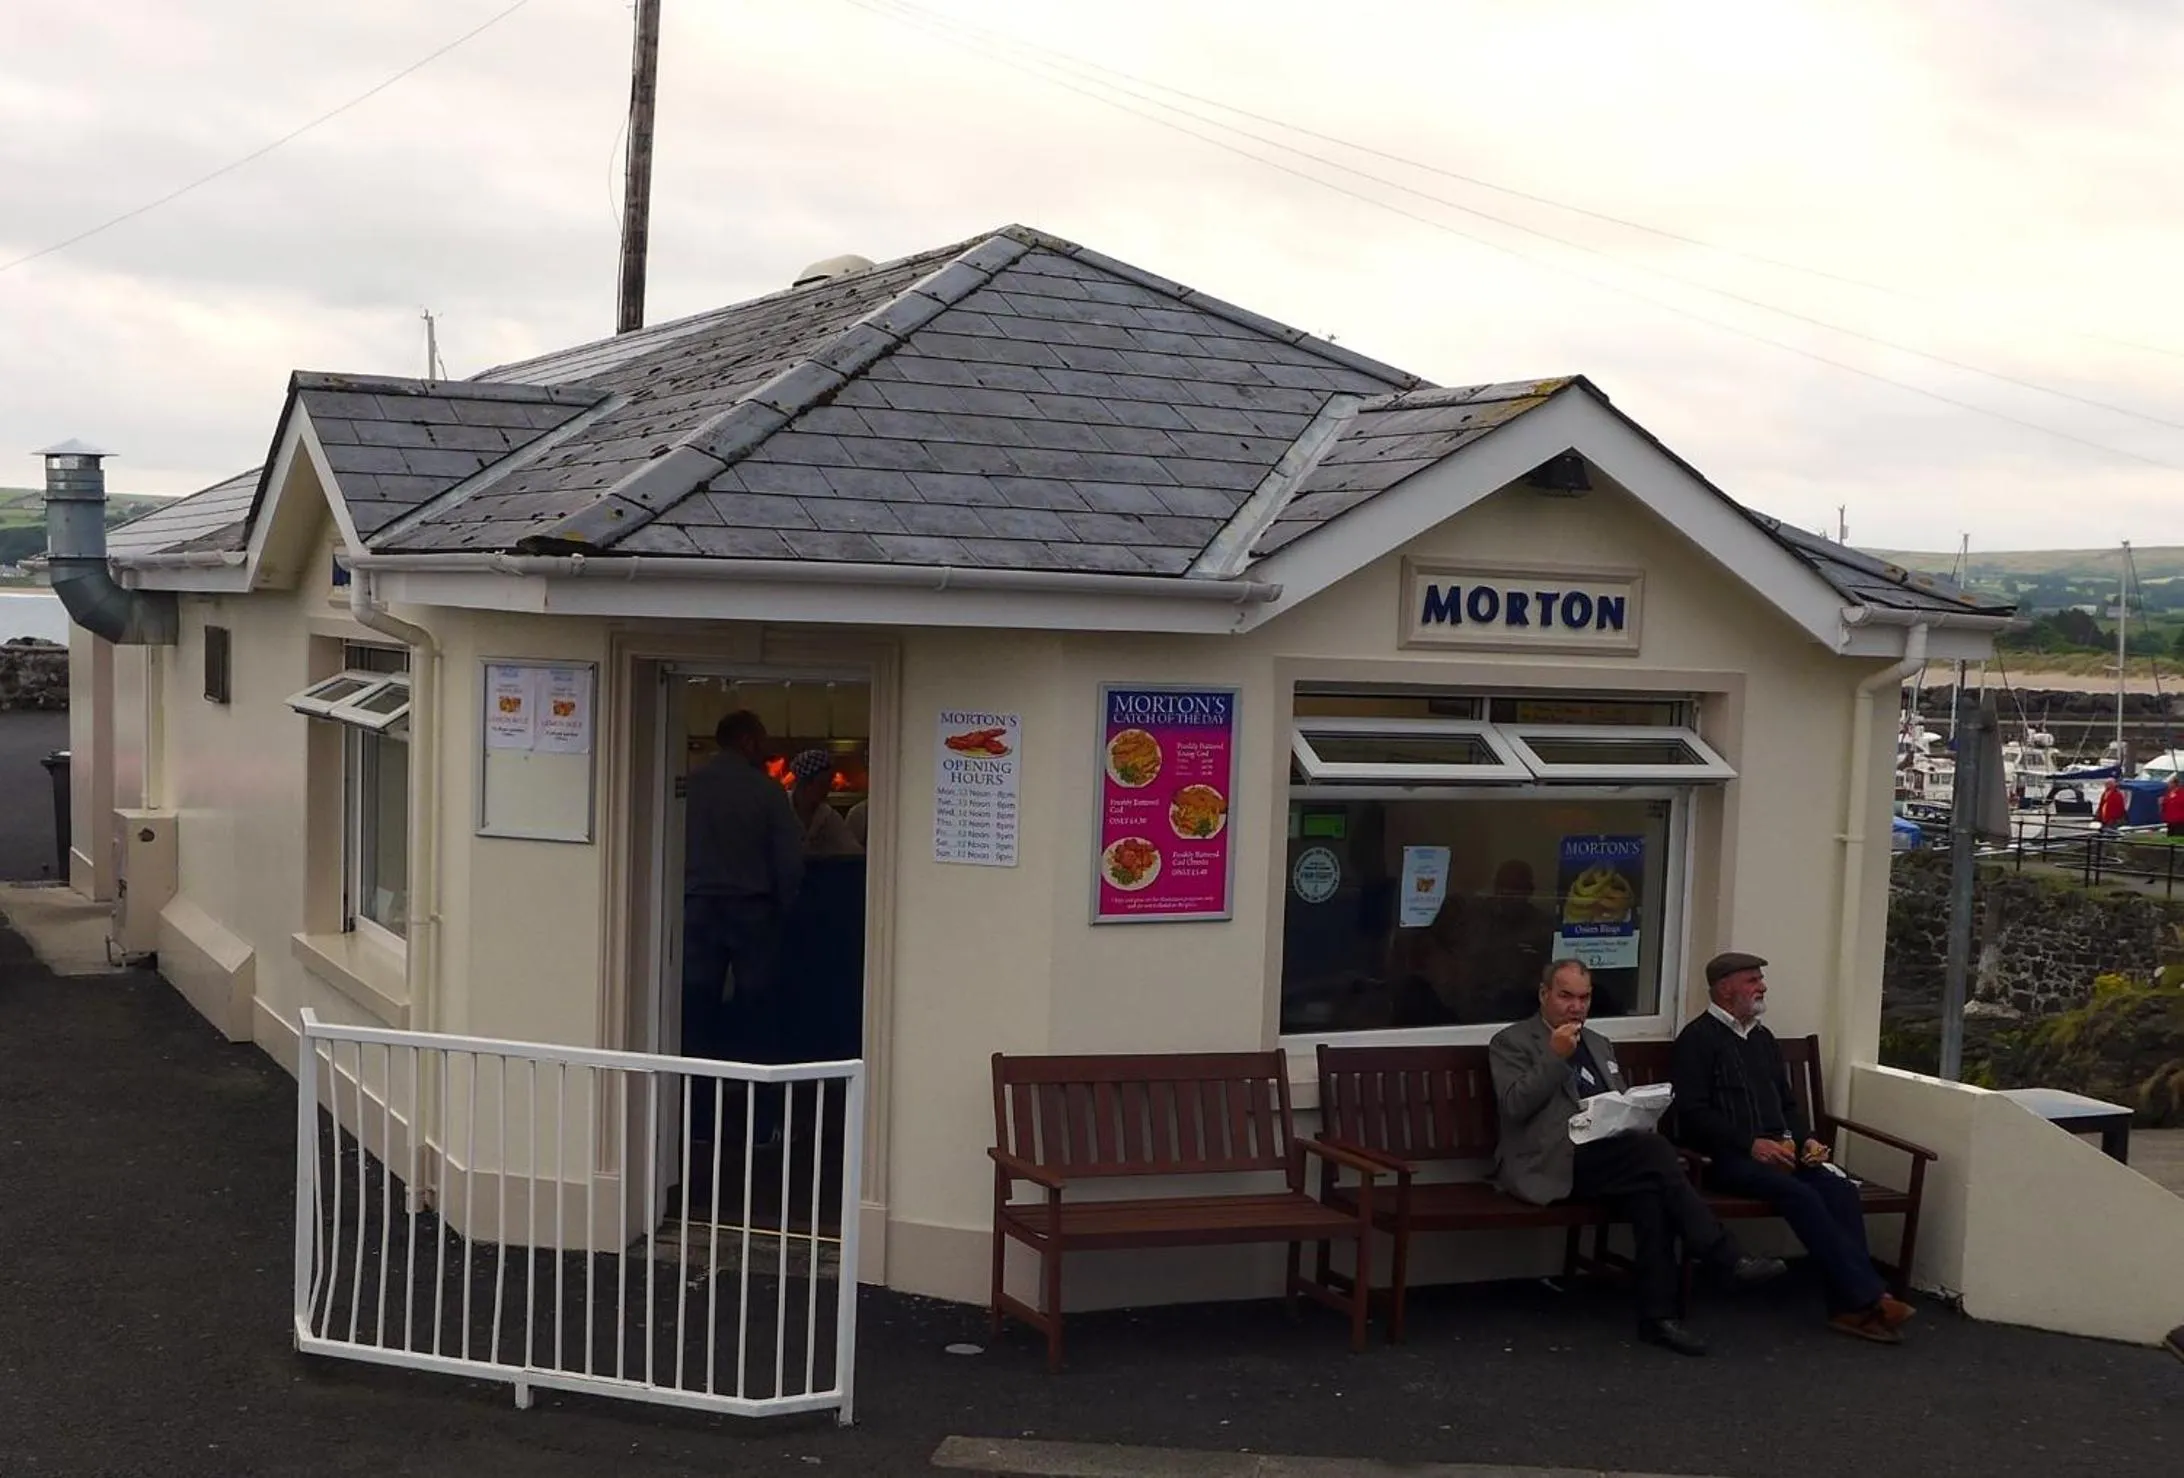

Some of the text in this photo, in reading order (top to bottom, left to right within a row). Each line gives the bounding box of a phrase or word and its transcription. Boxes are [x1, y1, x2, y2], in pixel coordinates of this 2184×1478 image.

[1422, 584, 1625, 630] MORTON
[1115, 695, 1225, 714] MORTON'S
[941, 712, 1017, 727] MORTON'S
[1113, 713, 1223, 725] CATCH OF THE DAY
[943, 759, 1012, 774] OPENING
[951, 772, 1003, 785] HOURS
[1566, 842, 1640, 855] MORTON'S
